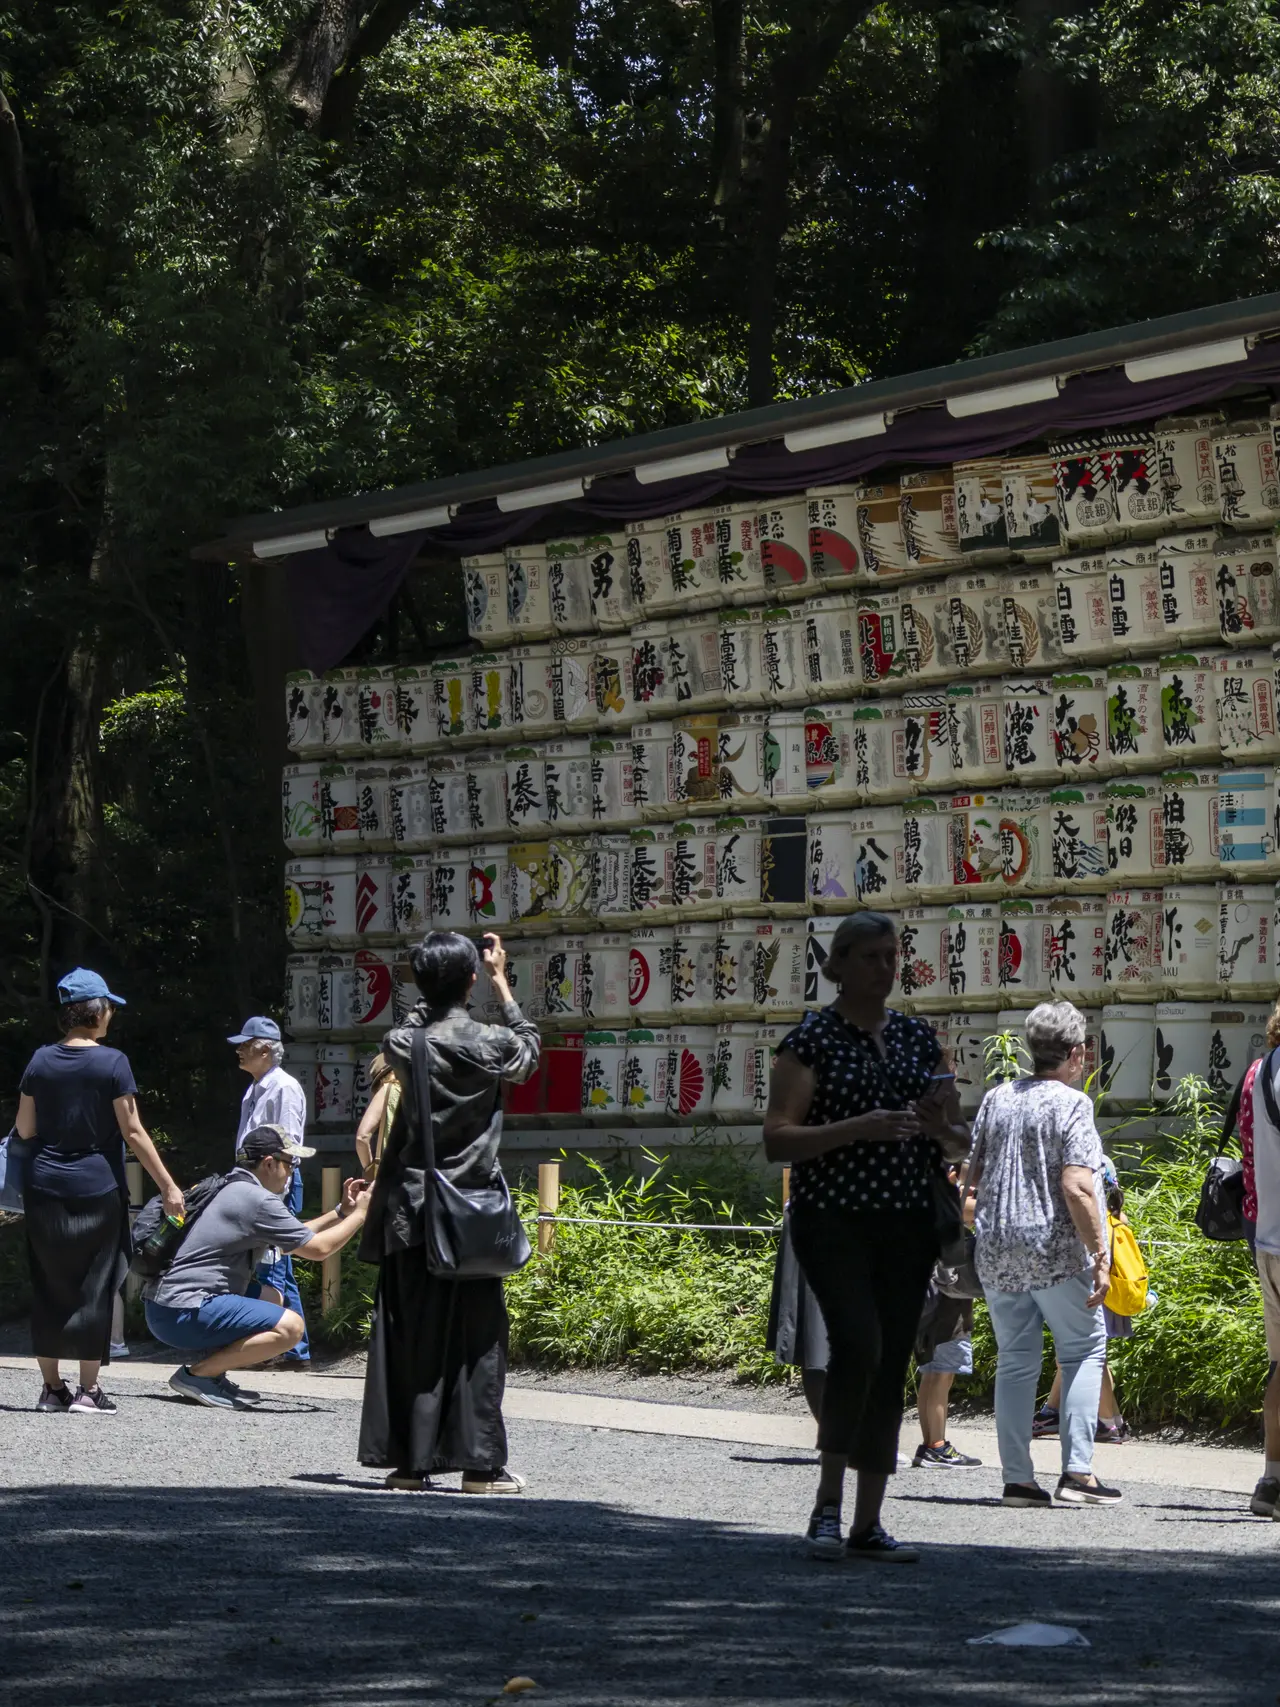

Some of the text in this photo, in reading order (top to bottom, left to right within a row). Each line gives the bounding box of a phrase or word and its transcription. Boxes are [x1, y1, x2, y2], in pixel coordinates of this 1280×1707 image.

[1185, 539, 1208, 550] 商標
[1160, 561, 1186, 624] 白雪
[792, 743, 800, 774] 埼玉
[1092, 927, 1103, 977] 日本酒
[1258, 917, 1267, 964] 寒造り清酒
[792, 944, 800, 986] キンシ正宗
[982, 951, 991, 984] 東山酒造
